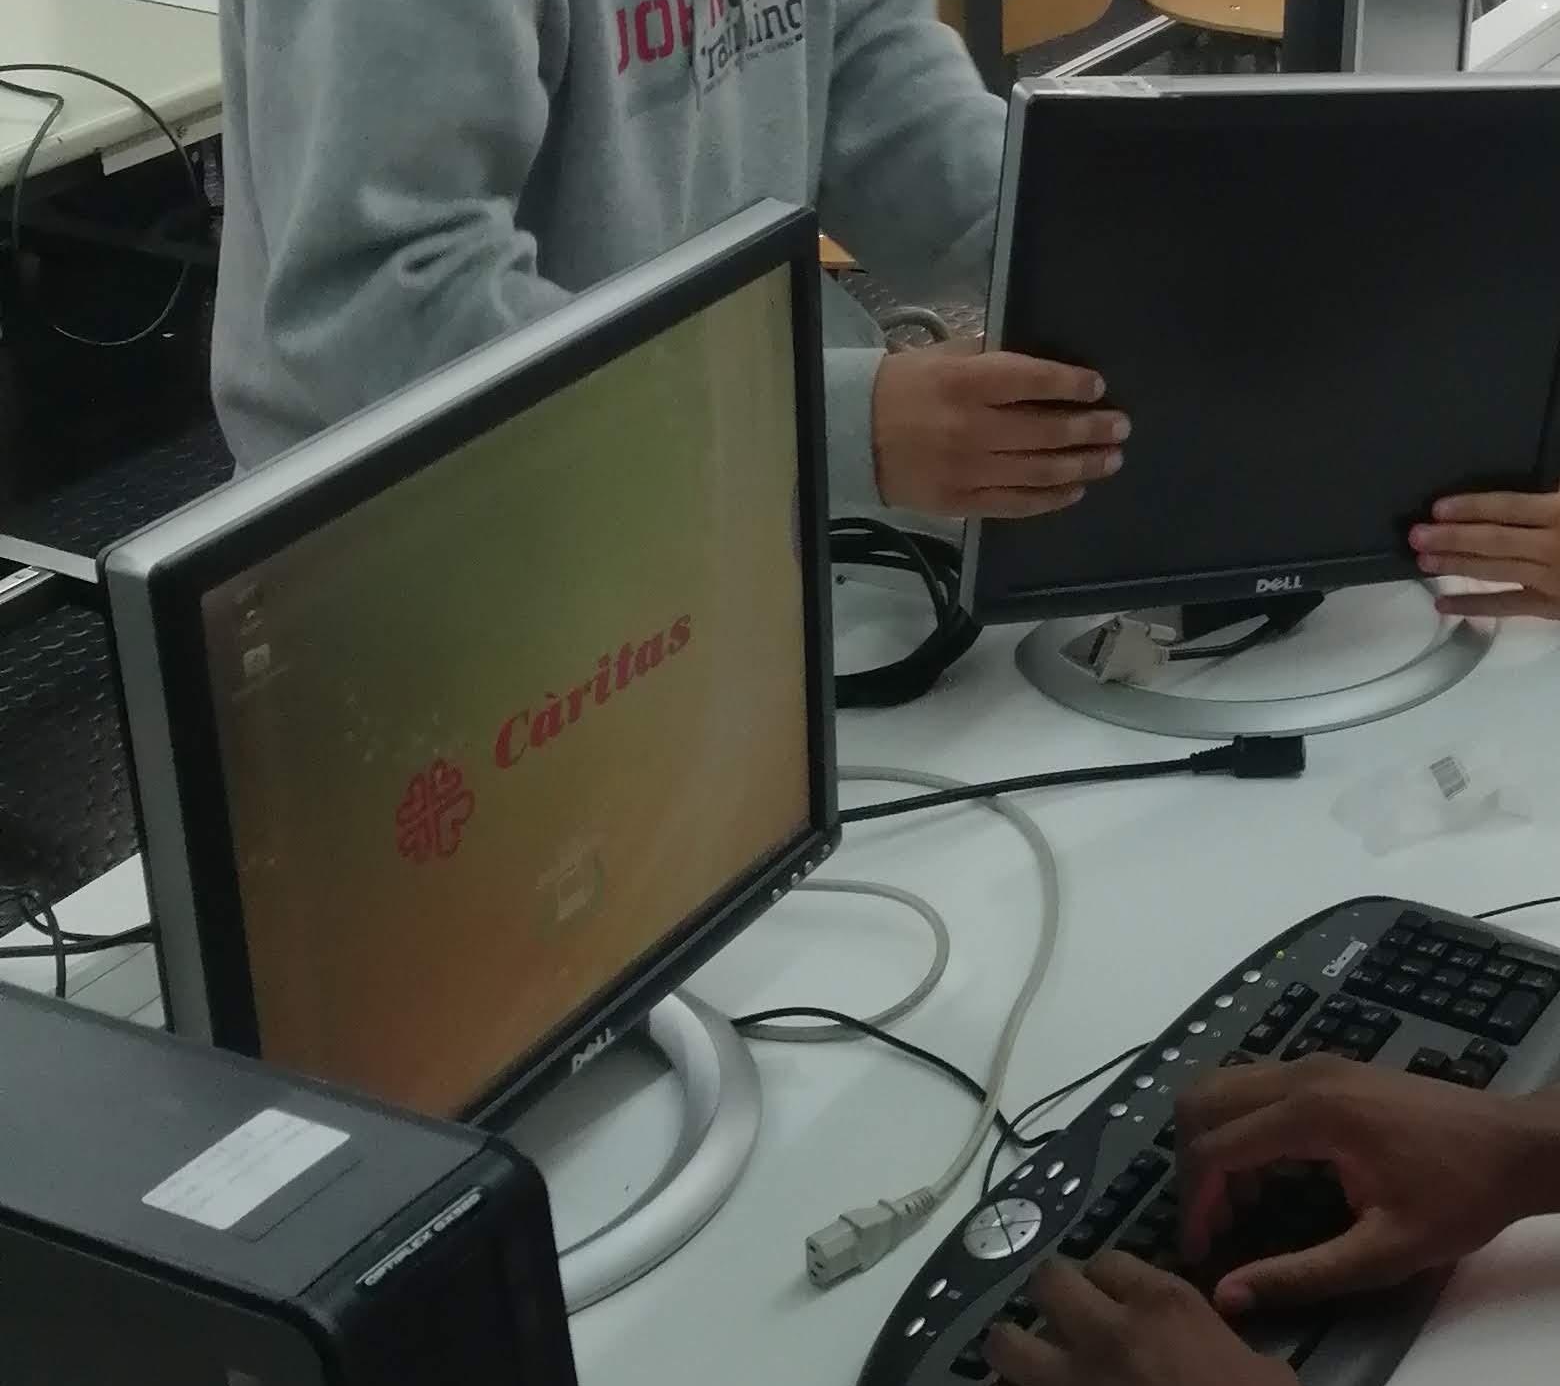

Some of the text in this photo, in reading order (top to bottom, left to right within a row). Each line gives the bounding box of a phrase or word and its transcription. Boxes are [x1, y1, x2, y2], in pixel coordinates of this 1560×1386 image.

[1255, 575, 1303, 593] DELL
[495, 613, 691, 769] Càritas
[571, 1027, 616, 1074] DELL
